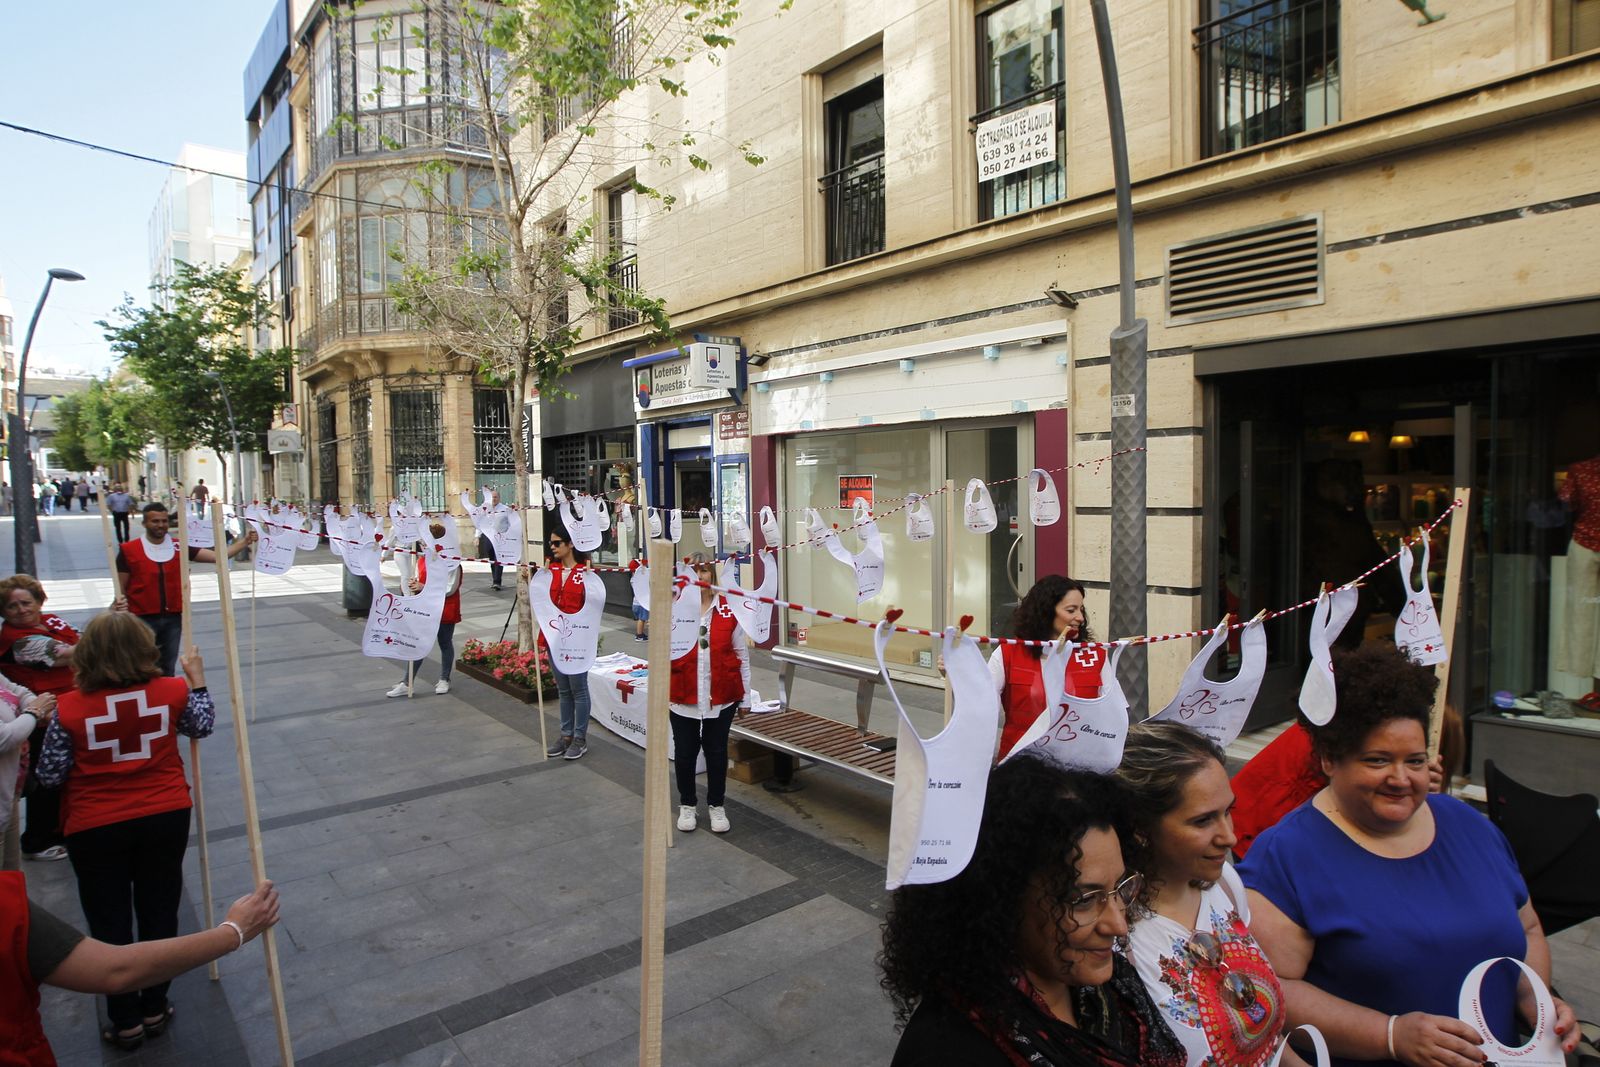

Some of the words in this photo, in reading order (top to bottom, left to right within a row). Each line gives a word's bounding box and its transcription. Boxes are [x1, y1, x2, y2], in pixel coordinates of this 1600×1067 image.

[979, 134, 986, 149] SE
[987, 125, 1014, 147] TRASPASA
[1014, 122, 1019, 138] O
[1020, 119, 1027, 136] SE
[1028, 111, 1053, 133] ALQUILA
[983, 147, 1001, 162] 639
[1004, 142, 1016, 156] 38
[1034, 132, 1048, 146] 24
[983, 162, 1001, 176] 950
[1004, 157, 1016, 170] 27
[1019, 152, 1032, 164] 44
[654, 364, 682, 379] Loterías
[683, 364, 688, 376] y
[655, 379, 687, 396] Apuestas
[840, 478, 848, 489] SE
[848, 477, 872, 489] ALQUILA
[916, 856, 926, 867] Roja
[927, 856, 948, 867] Española
